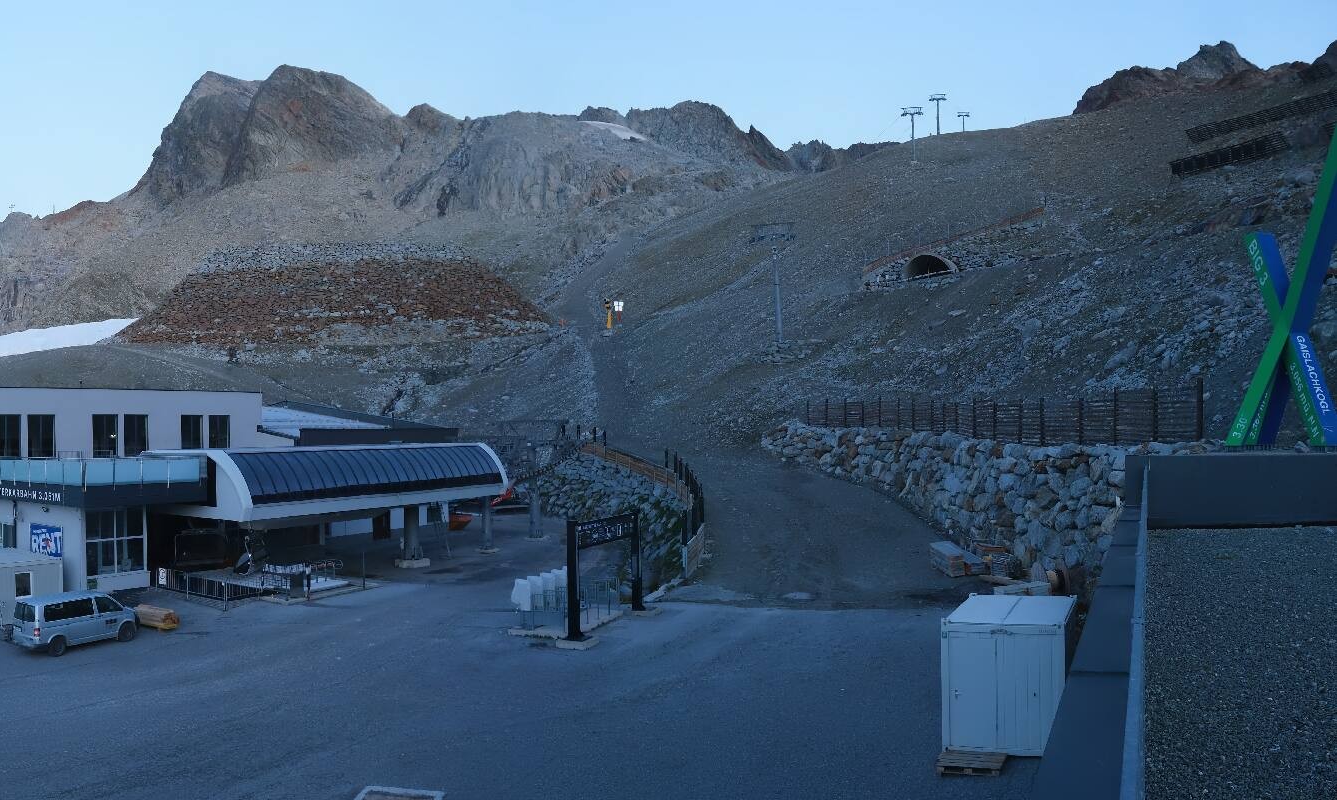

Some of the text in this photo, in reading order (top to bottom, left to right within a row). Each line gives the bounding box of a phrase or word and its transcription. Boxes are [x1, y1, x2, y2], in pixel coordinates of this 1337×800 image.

[1248, 239, 1268, 286] BIG 3
[1296, 335, 1332, 415] GAISLACHKOGL
[31, 531, 62, 554] RENT
